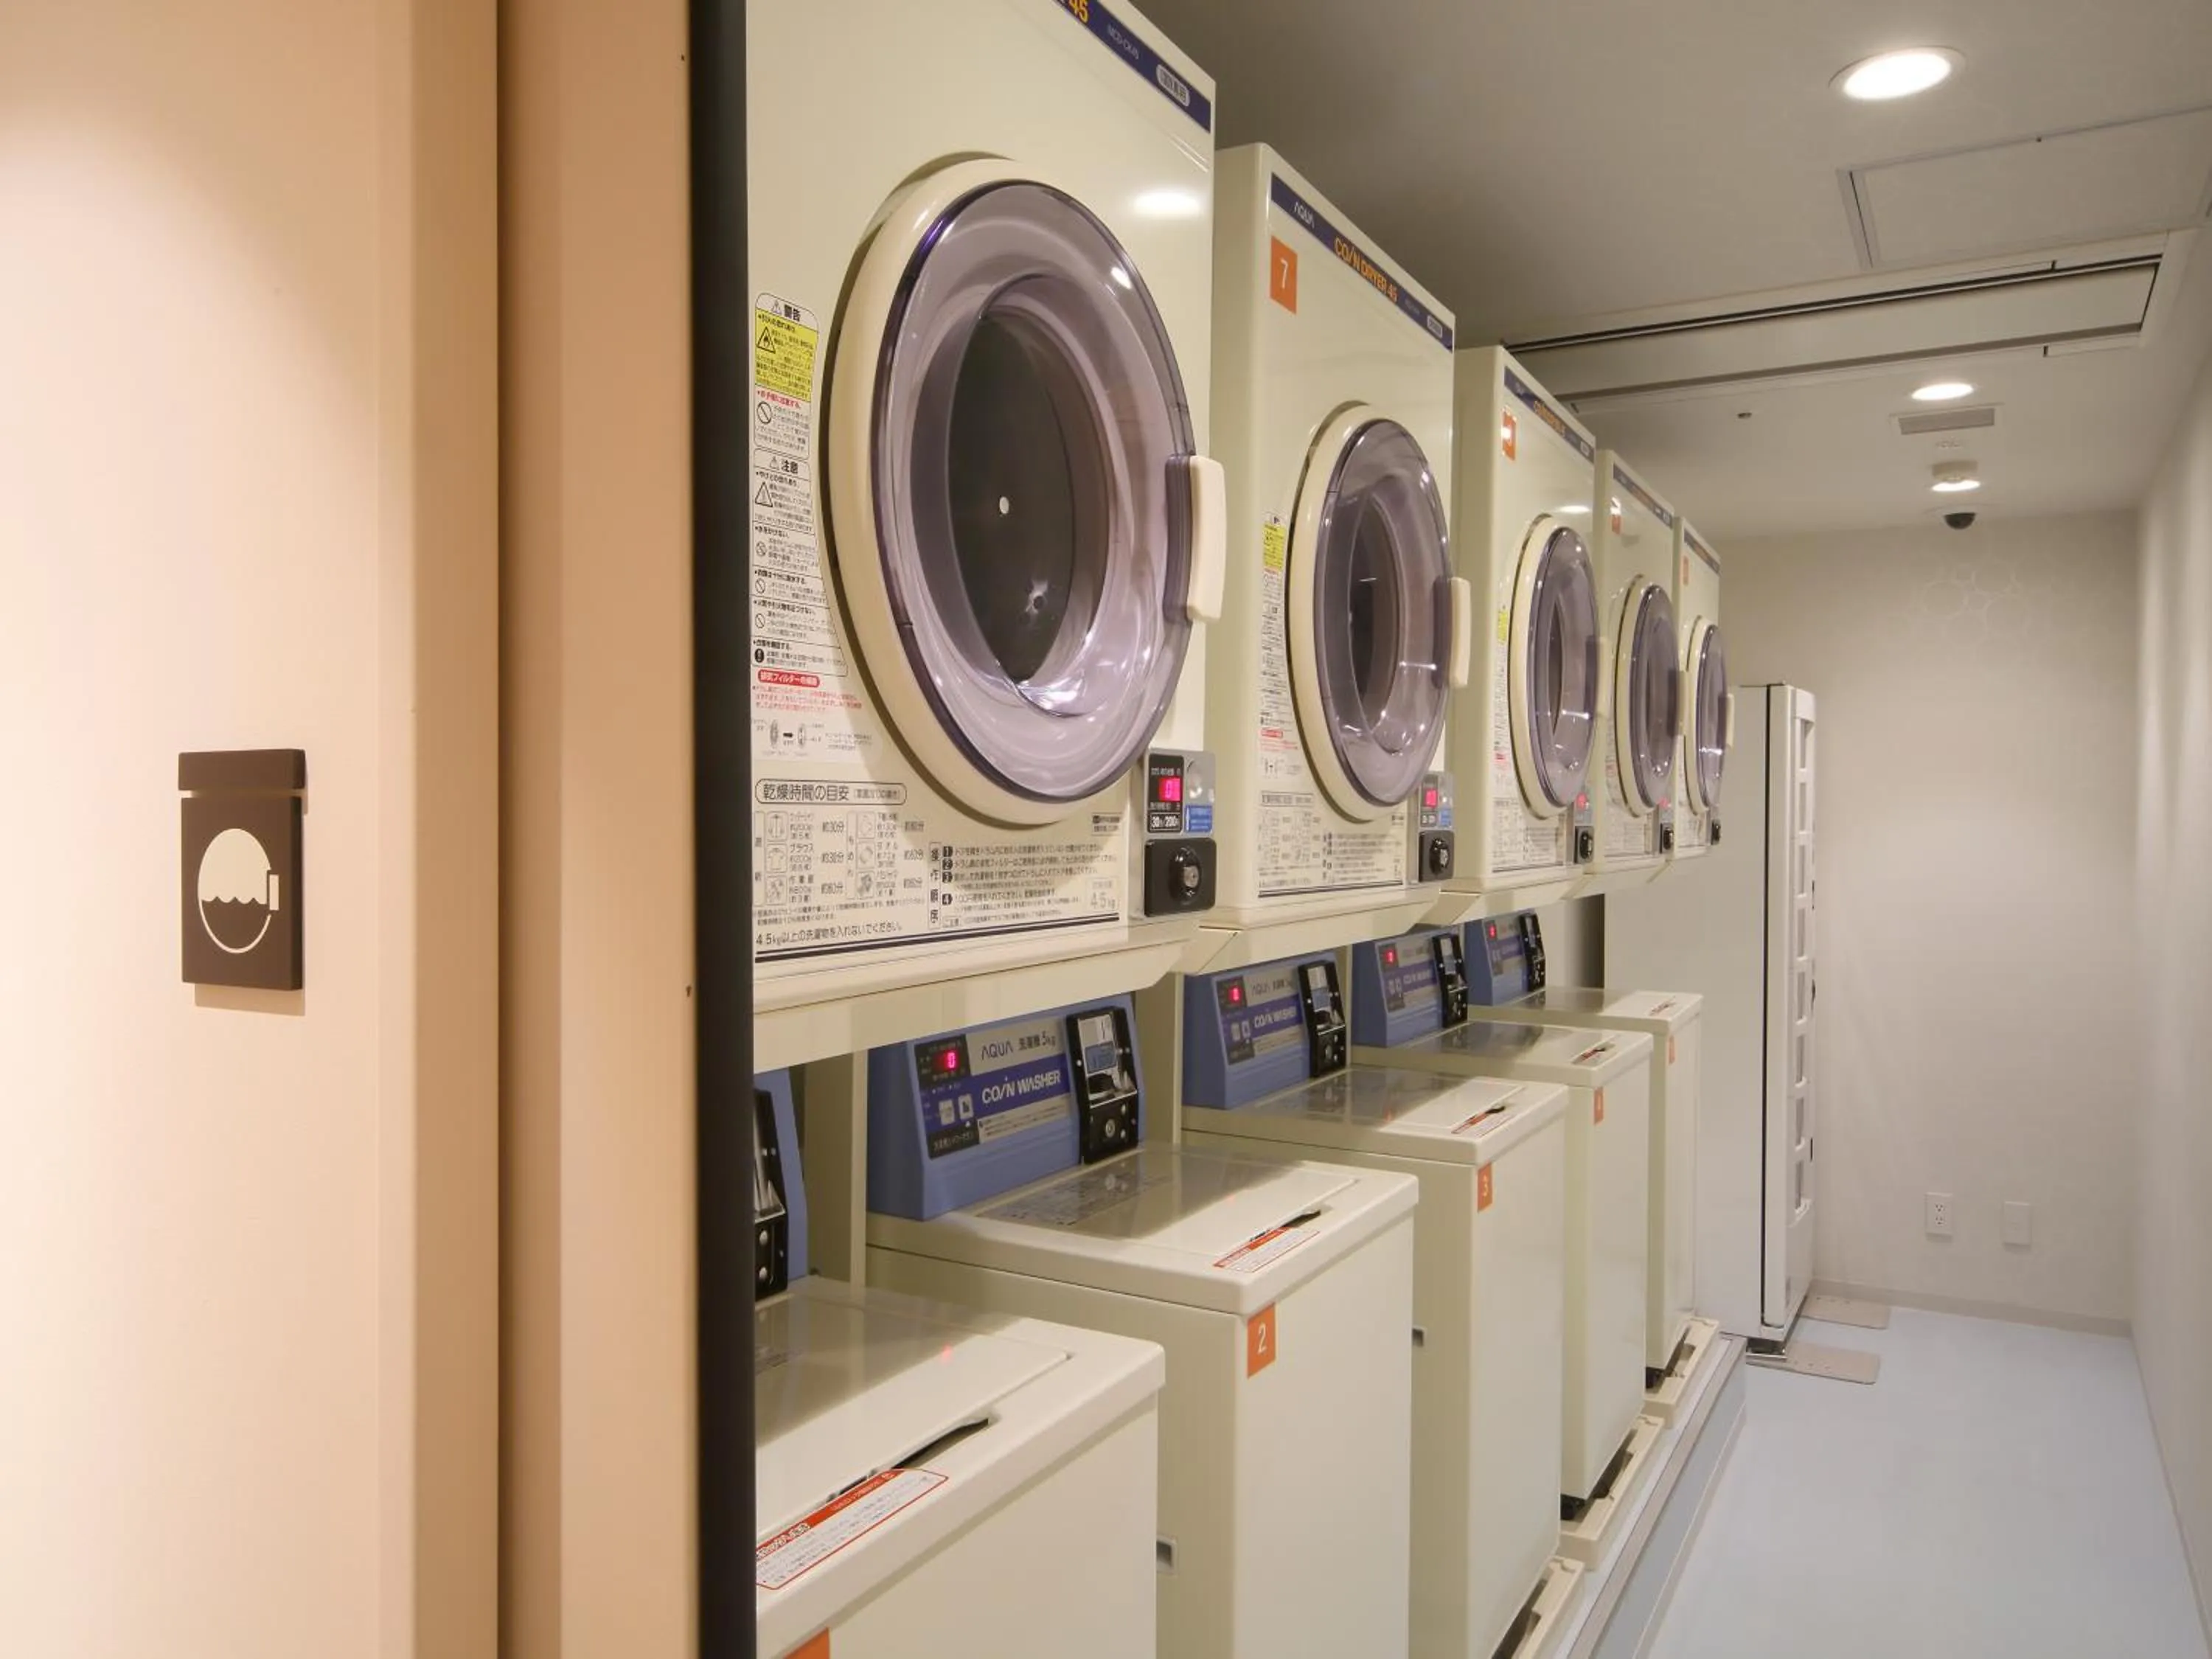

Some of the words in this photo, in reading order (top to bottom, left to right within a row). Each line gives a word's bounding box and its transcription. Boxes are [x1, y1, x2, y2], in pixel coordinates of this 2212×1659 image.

[1280, 258, 1289, 290] 7
[763, 784, 849, 801] 乾燥時間の目安
[947, 1051, 956, 1069] 0
[981, 1040, 1014, 1060] AQUA
[1018, 1069, 1062, 1096] WASHER
[1256, 1322, 1267, 1355] 2
